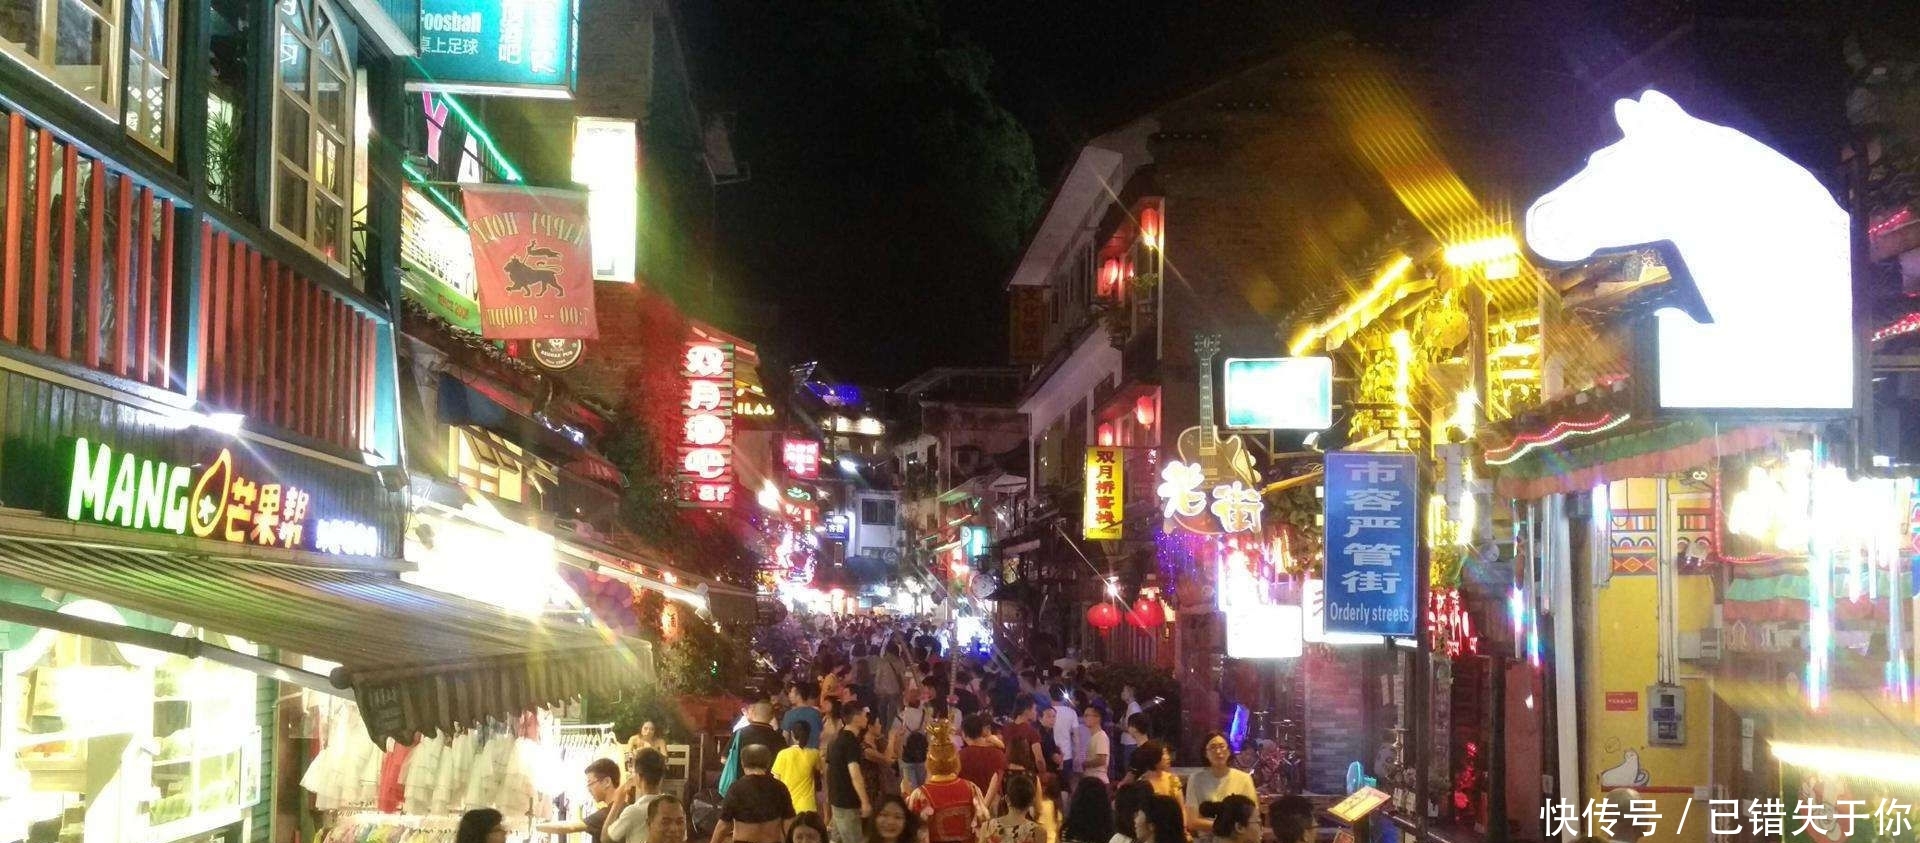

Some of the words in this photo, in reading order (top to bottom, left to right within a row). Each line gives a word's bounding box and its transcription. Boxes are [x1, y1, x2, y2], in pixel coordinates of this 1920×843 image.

[1096, 451, 1115, 524] 双月桥客栈
[1157, 461, 1264, 533] 老街
[1341, 461, 1403, 594] 市容严管街
[1330, 602, 1369, 623] Orderly
[1371, 604, 1410, 622] streets
